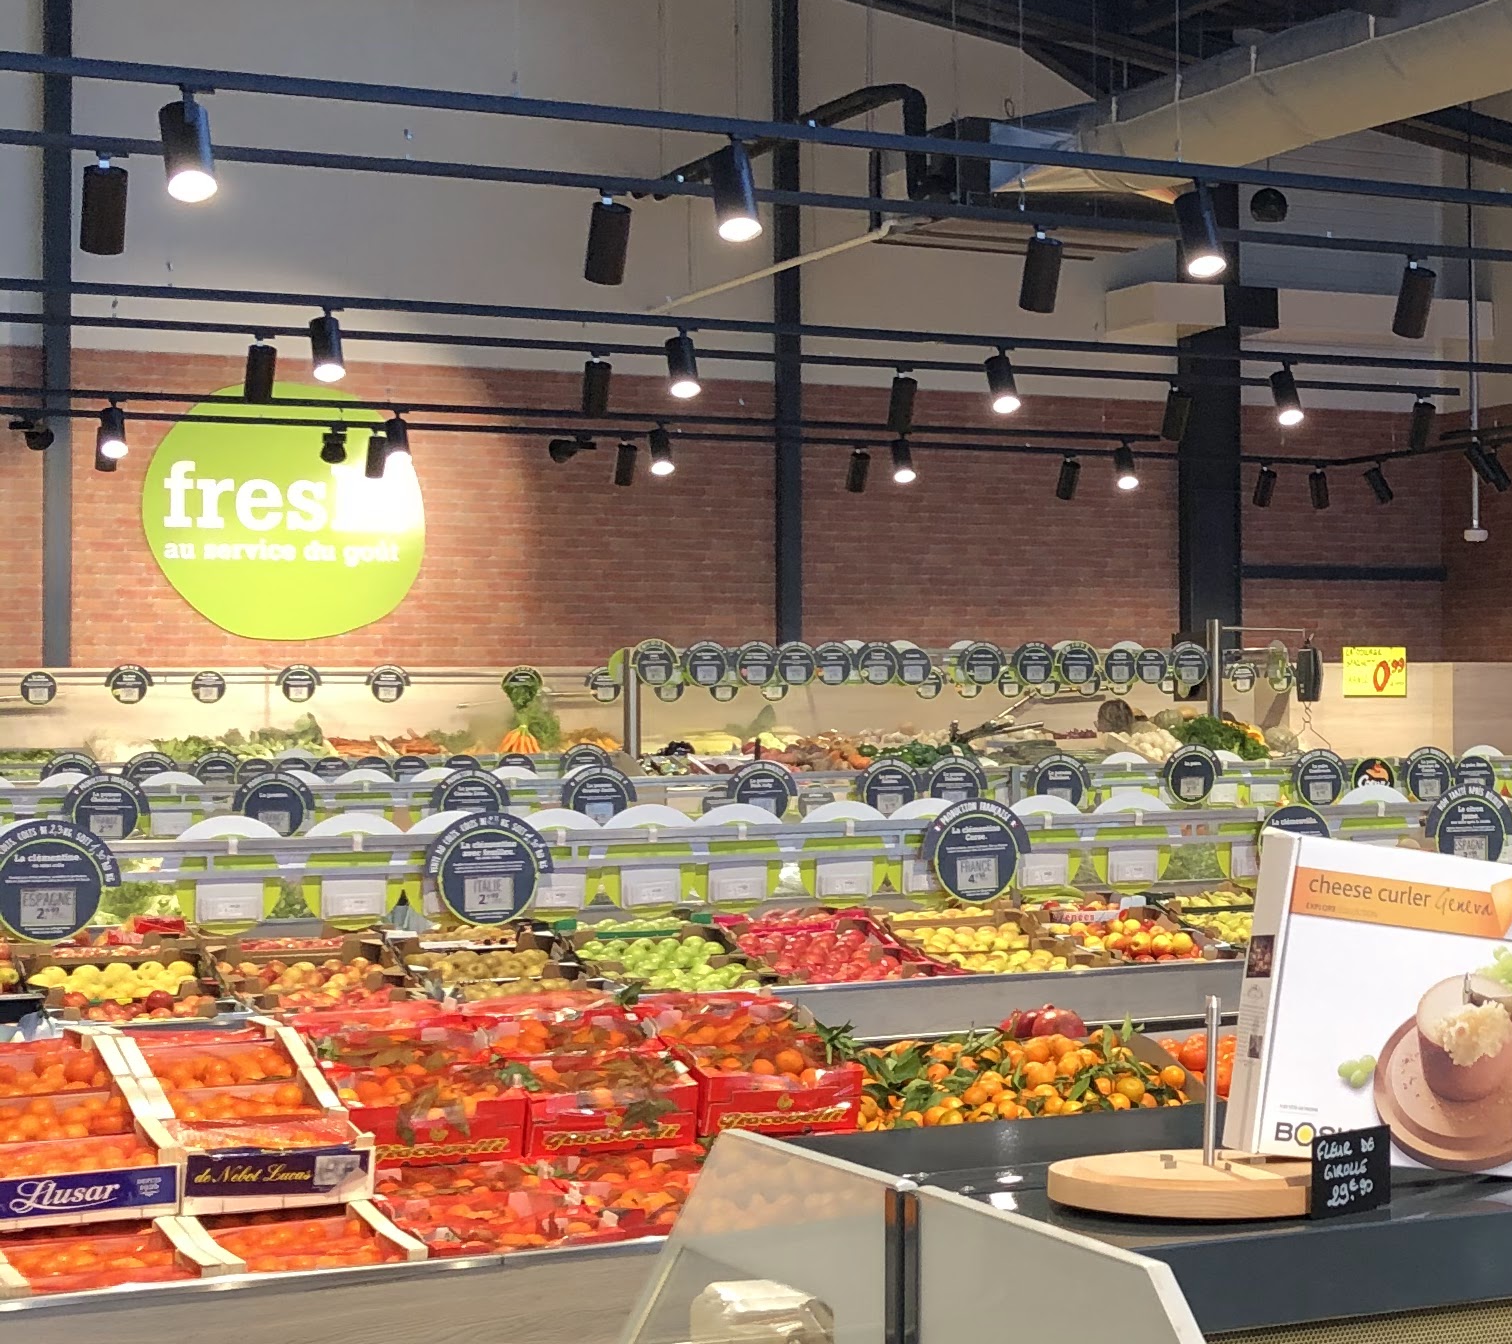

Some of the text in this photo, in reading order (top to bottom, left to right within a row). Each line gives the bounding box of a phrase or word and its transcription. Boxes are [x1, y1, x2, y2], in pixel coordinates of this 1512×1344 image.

[163, 542, 196, 560] au
[203, 539, 296, 561] service
[303, 540, 336, 562] du
[1308, 874, 1493, 916] cheese curler Geneva
[1317, 1139, 1353, 1161] FLEUR
[212, 1165, 262, 1184] Nebot
[262, 1163, 311, 1182] Lucas
[9, 1179, 120, 1214] Llusar
